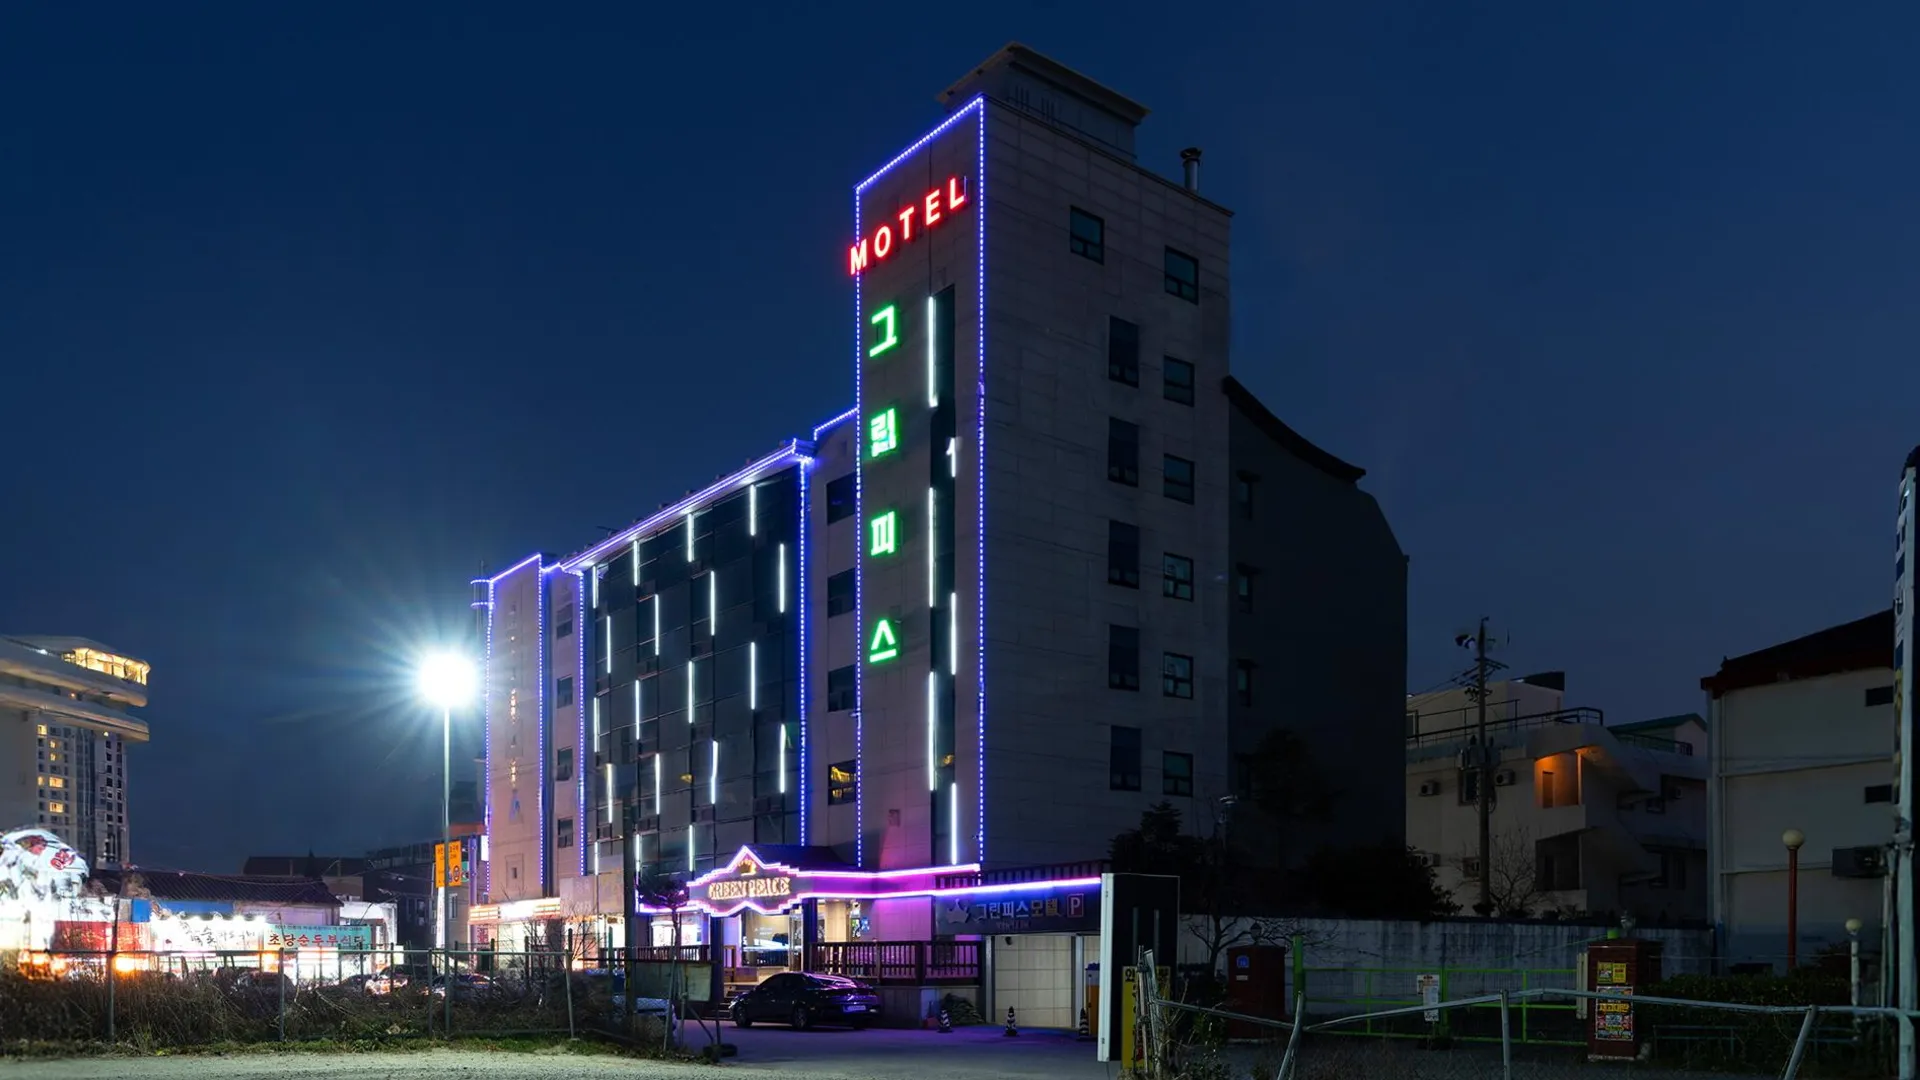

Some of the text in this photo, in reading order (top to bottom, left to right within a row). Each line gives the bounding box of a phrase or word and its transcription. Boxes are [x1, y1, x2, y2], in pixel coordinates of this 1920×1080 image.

[851, 178, 965, 275] MOTEL
[869, 304, 897, 663] 그린피스
[708, 876, 791, 900] GREEN PEACE
[1070, 896, 1081, 916] P
